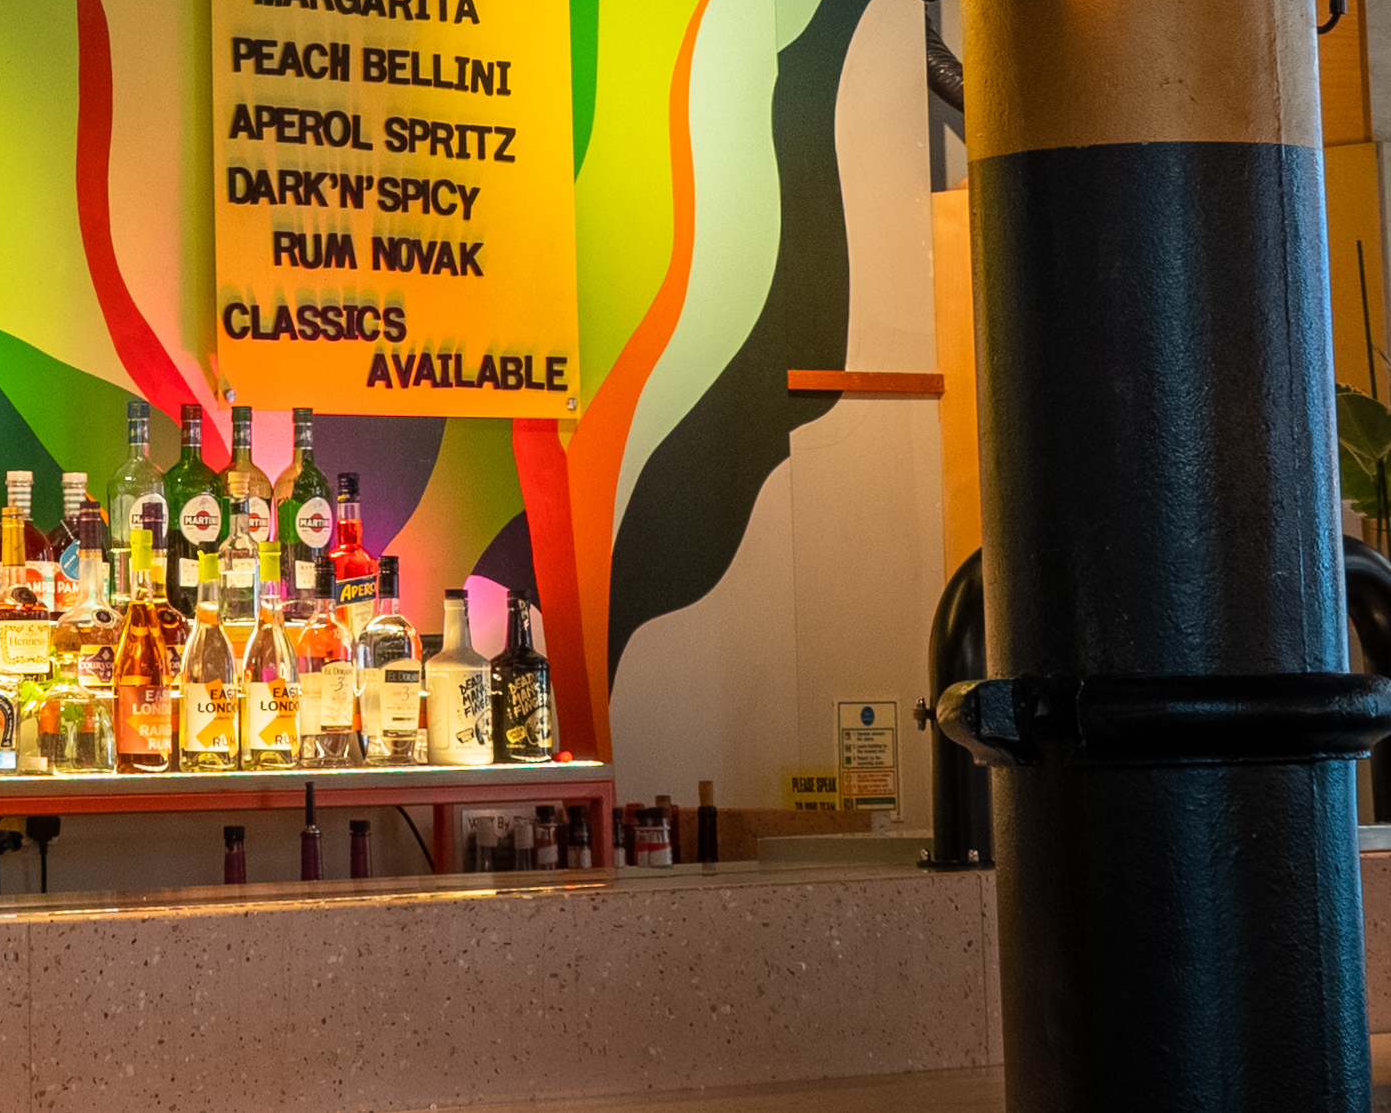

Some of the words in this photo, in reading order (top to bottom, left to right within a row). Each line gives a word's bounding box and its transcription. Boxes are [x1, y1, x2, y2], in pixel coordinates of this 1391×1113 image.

[232, 37, 350, 82] PEACH
[363, 47, 511, 96] BELLINI
[229, 104, 373, 150] APEROL
[384, 116, 517, 163] SPRITZ
[273, 231, 357, 270] RUM
[372, 236, 484, 277] NOVAK
[223, 302, 407, 343] CLASSICS
[367, 352, 568, 392] AVAILABLE
[340, 582, 376, 602] APERO
[459, 674, 483, 695] DEAD
[508, 672, 535, 695] DEAD
[212, 737, 236, 747] RUM
[274, 735, 298, 745] RUM
[791, 776, 815, 793] PLEASE
[816, 776, 837, 793] SPEAK
